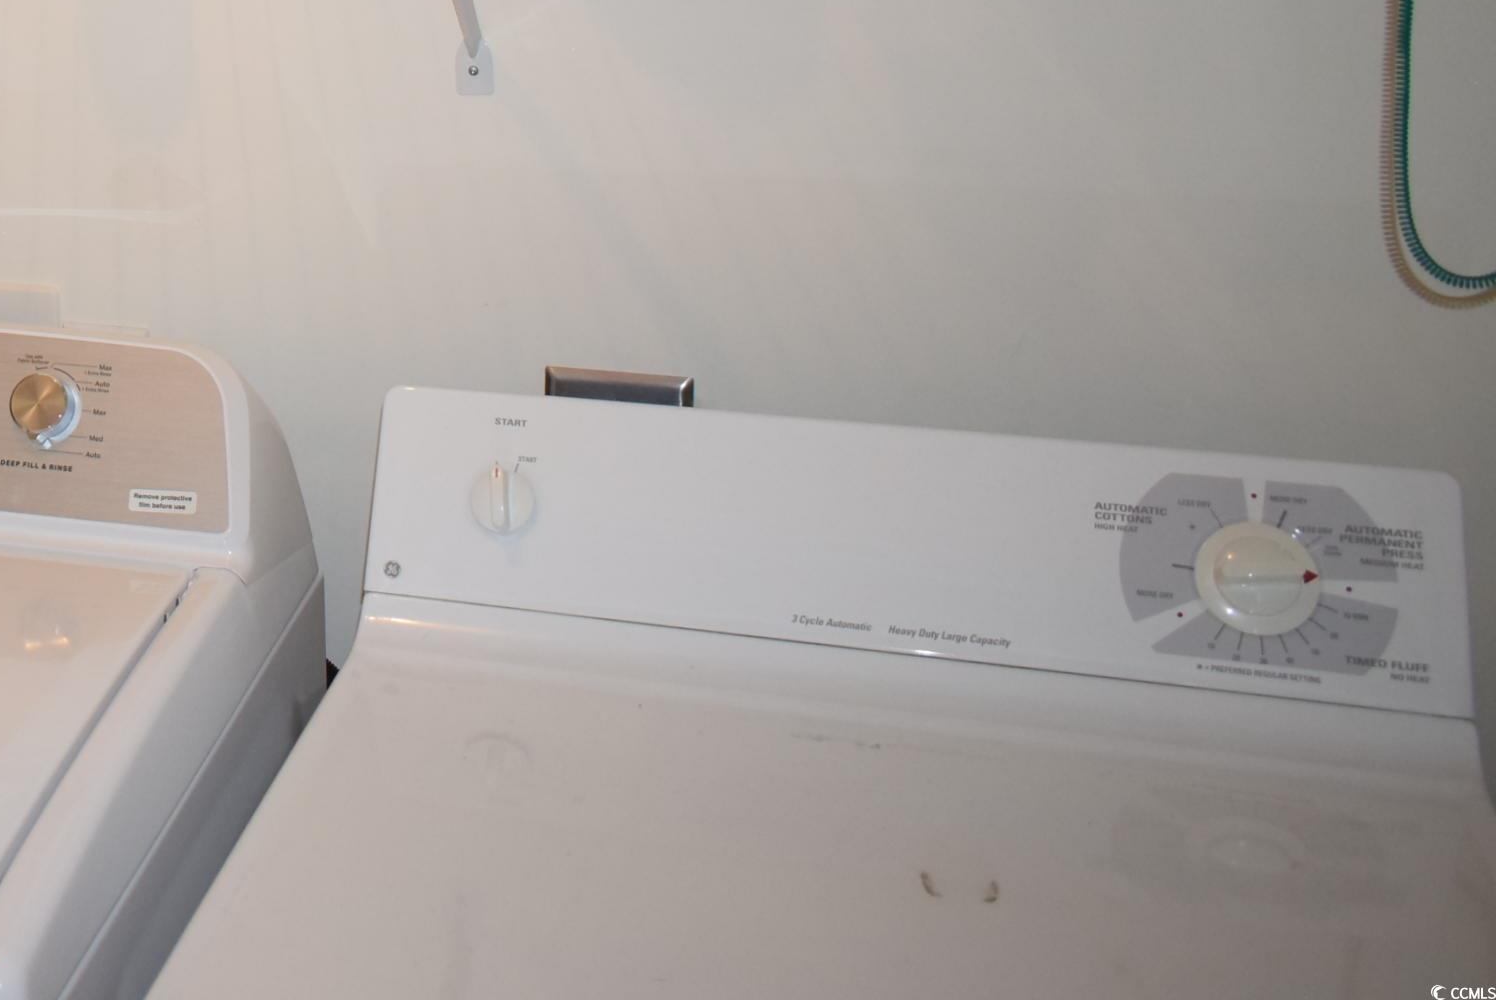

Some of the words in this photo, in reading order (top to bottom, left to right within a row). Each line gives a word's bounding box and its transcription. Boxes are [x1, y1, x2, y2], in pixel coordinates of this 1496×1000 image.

[494, 417, 528, 428] START
[0, 459, 21, 467] DEEP
[22, 460, 39, 469] FILL
[49, 464, 73, 472] RINSE
[1094, 502, 1168, 517] AUTOMATIC
[1094, 511, 1153, 525] COTTONS
[1094, 522, 1115, 531] HIGH
[1117, 525, 1139, 533] HEAT
[1344, 524, 1423, 540] AUTOMATIC
[1339, 534, 1423, 550] PERMANENT
[1381, 548, 1424, 560] PRESS
[1400, 562, 1425, 570] HEAT
[791, 614, 798, 624] 3
[799, 615, 824, 627] Cycle
[825, 618, 872, 632] Automatic
[888, 624, 916, 638] Heavy
[918, 628, 940, 640] Duty
[941, 631, 968, 643] Large
[969, 634, 1012, 648] Capacity
[1344, 655, 1388, 669] TIMED
[1391, 661, 1431, 673] FLUFF
[1210, 665, 1253, 676] PREFERRED
[1253, 669, 1288, 680] REGULAR
[1289, 673, 1322, 684] SETTING
[1390, 673, 1405, 682] NO
[1406, 675, 1430, 684] HEAT
